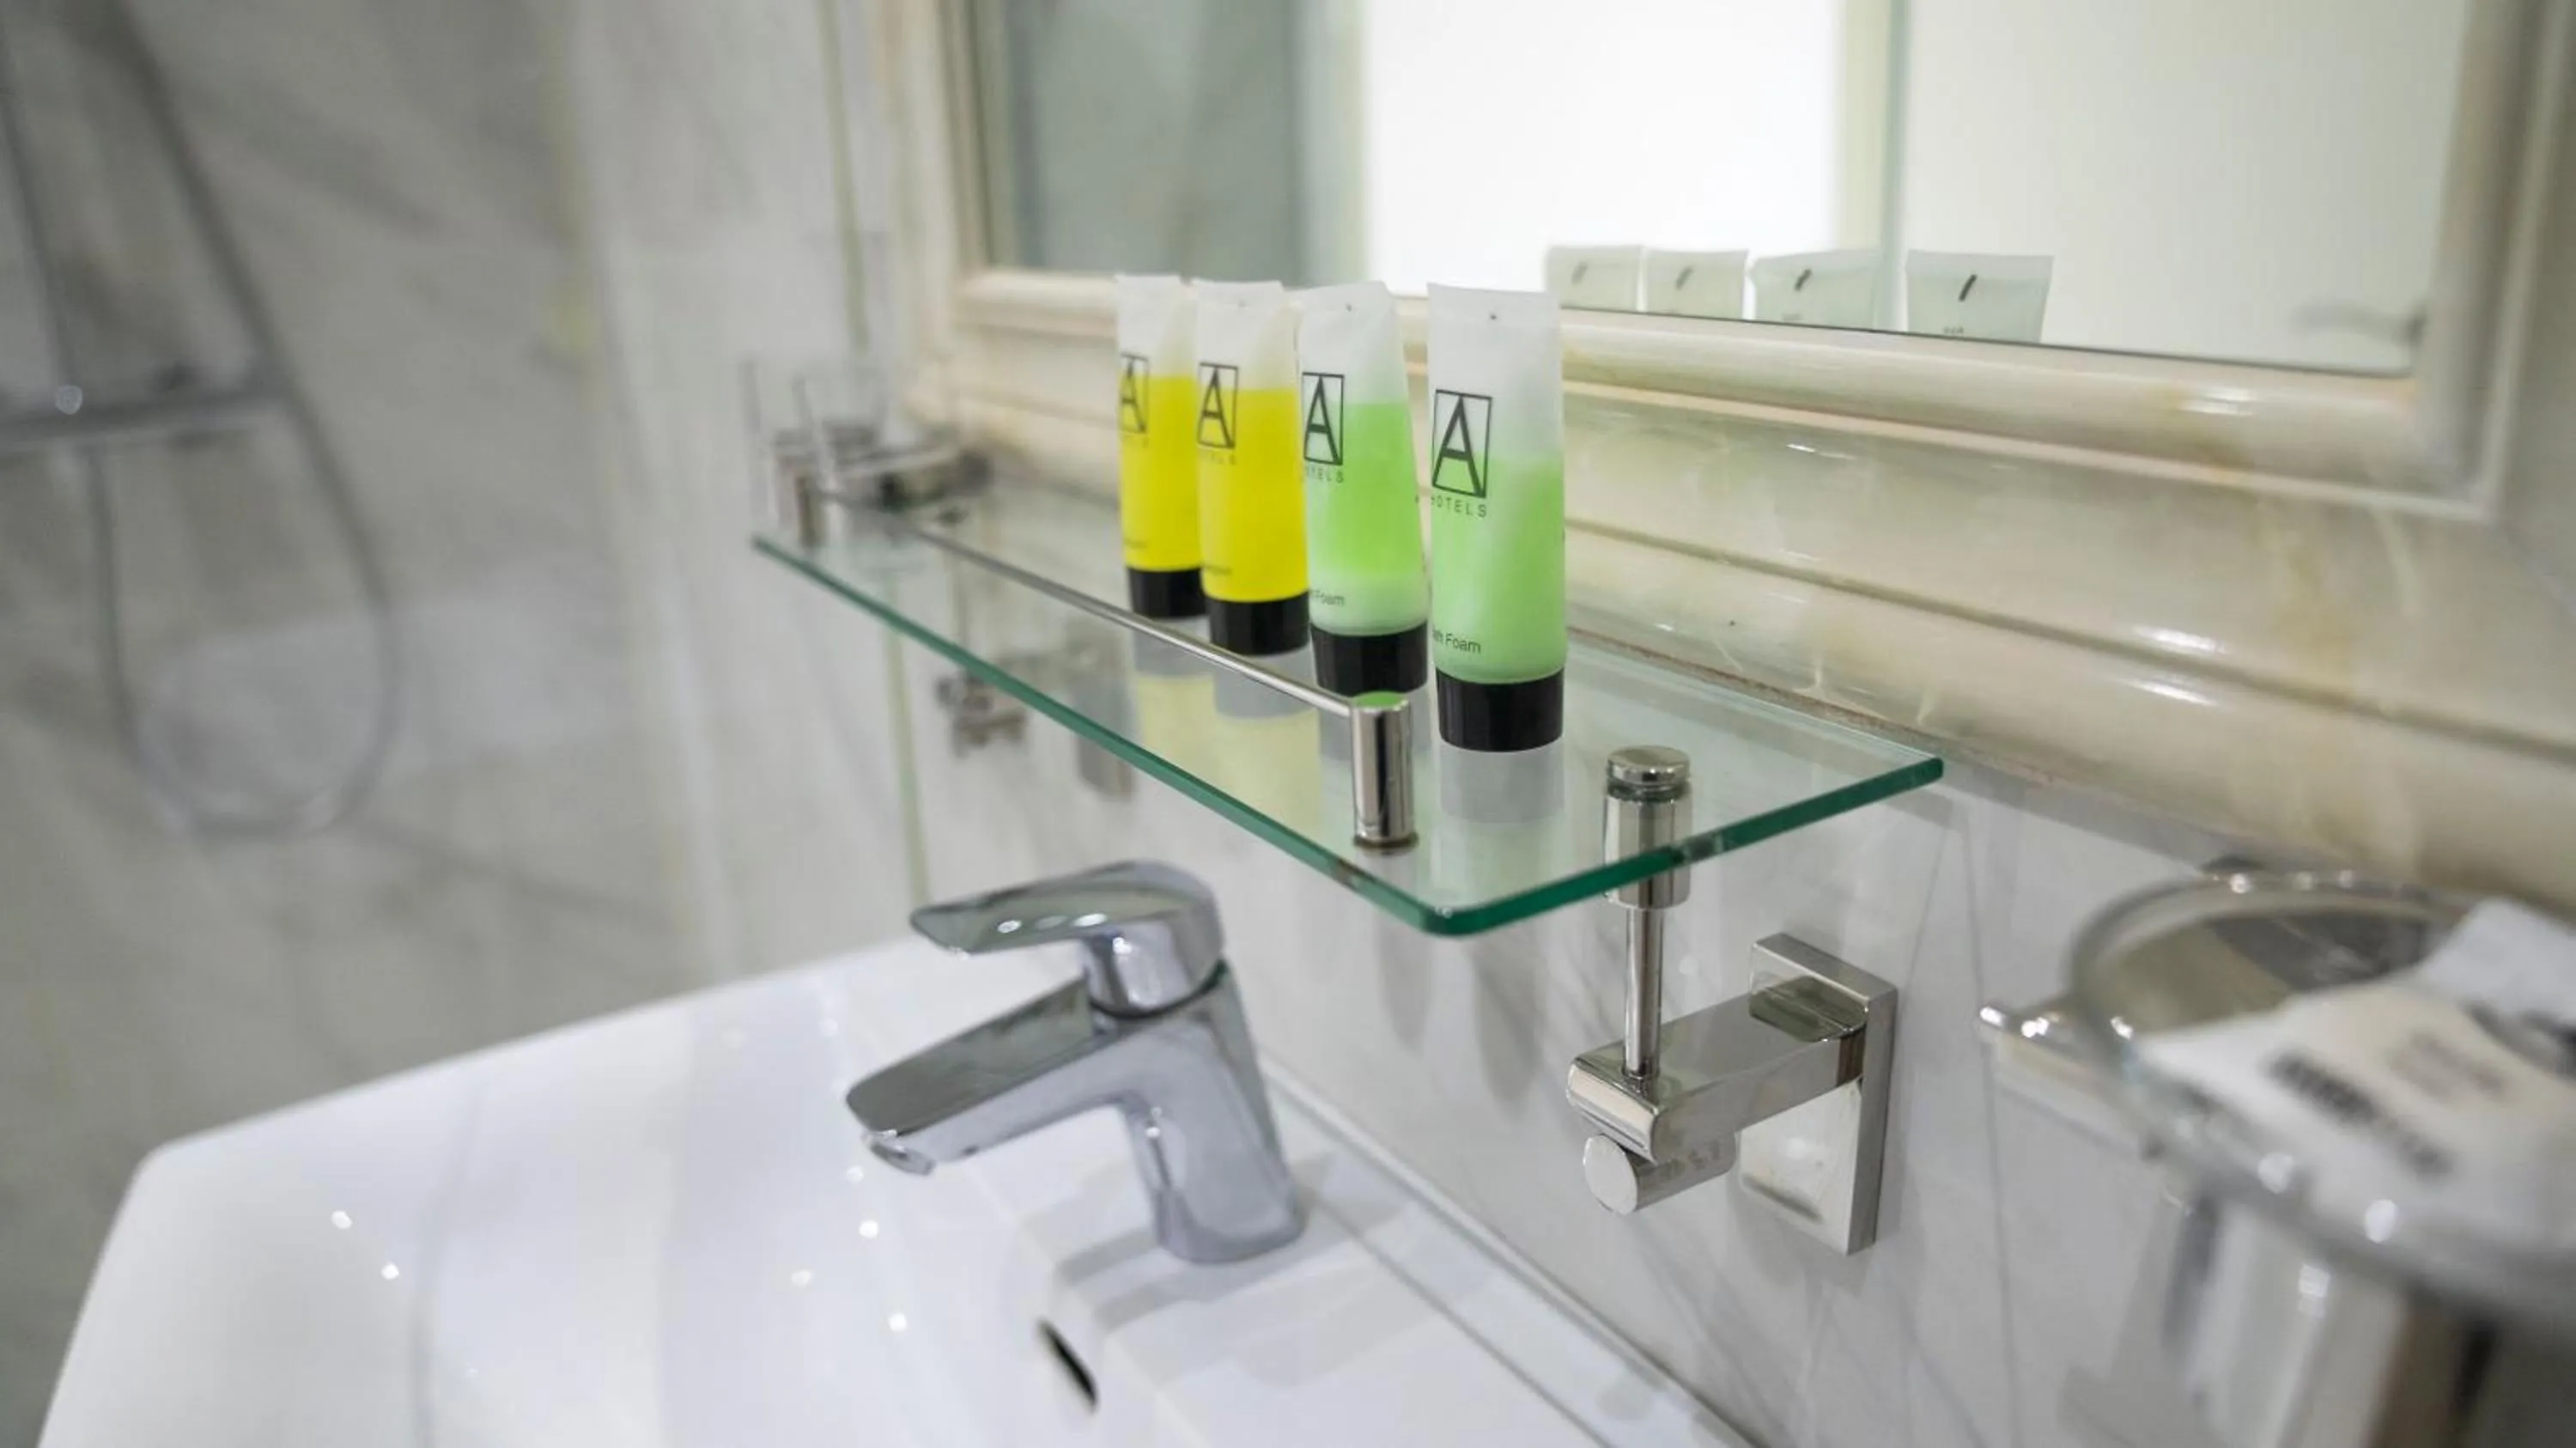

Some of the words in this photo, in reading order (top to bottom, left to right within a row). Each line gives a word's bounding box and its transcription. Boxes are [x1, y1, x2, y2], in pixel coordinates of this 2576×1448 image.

[1197, 362, 1236, 449] A
[1303, 372, 1344, 465] A
[1432, 390, 1492, 499] A
[1445, 632, 1481, 654] Foam
